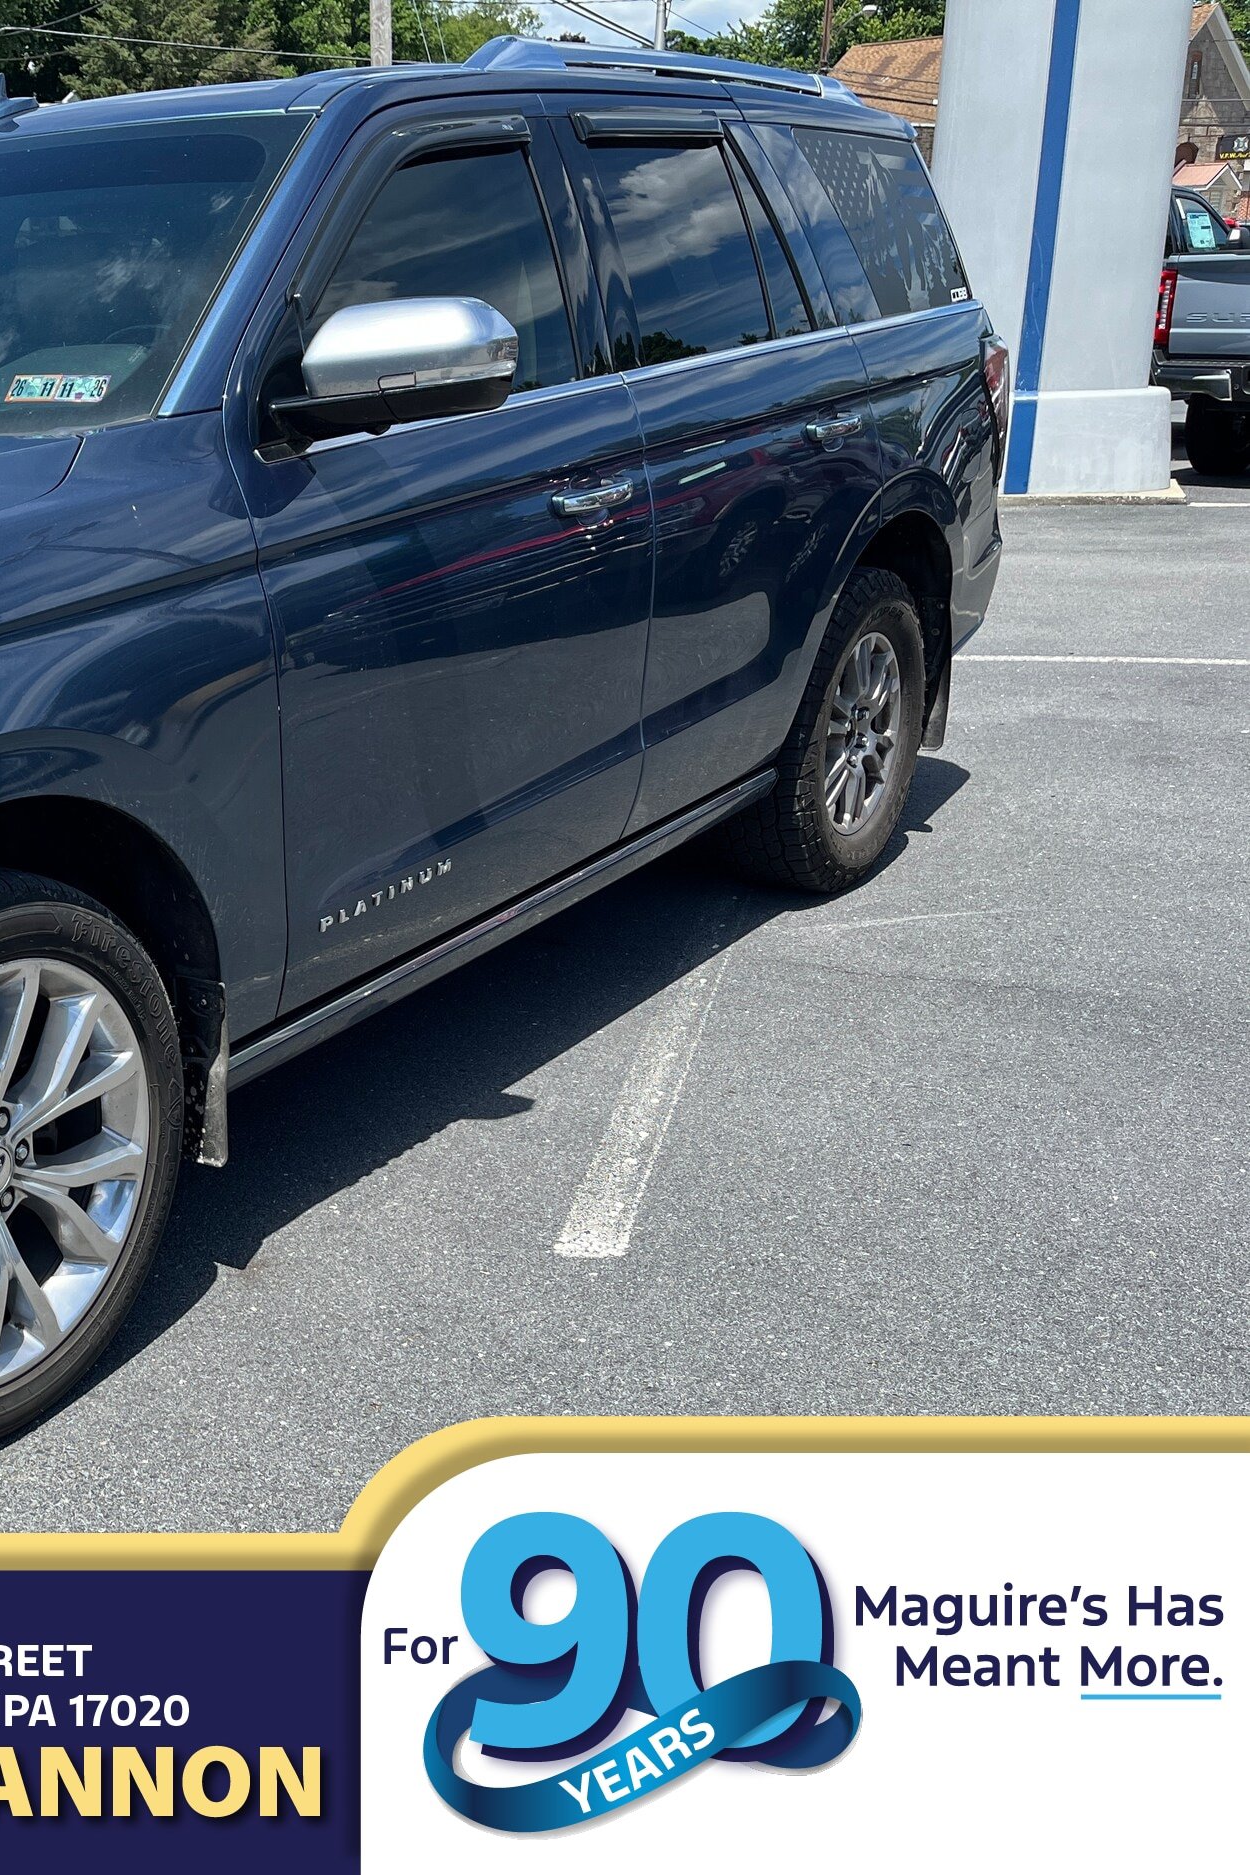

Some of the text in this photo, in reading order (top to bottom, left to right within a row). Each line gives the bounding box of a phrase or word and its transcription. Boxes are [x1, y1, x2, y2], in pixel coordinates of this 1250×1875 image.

[11, 379, 55, 397] 26 11
[58, 379, 107, 398] 11 26
[319, 858, 452, 933] PLATINUM
[71, 912, 180, 1070] Firestone
